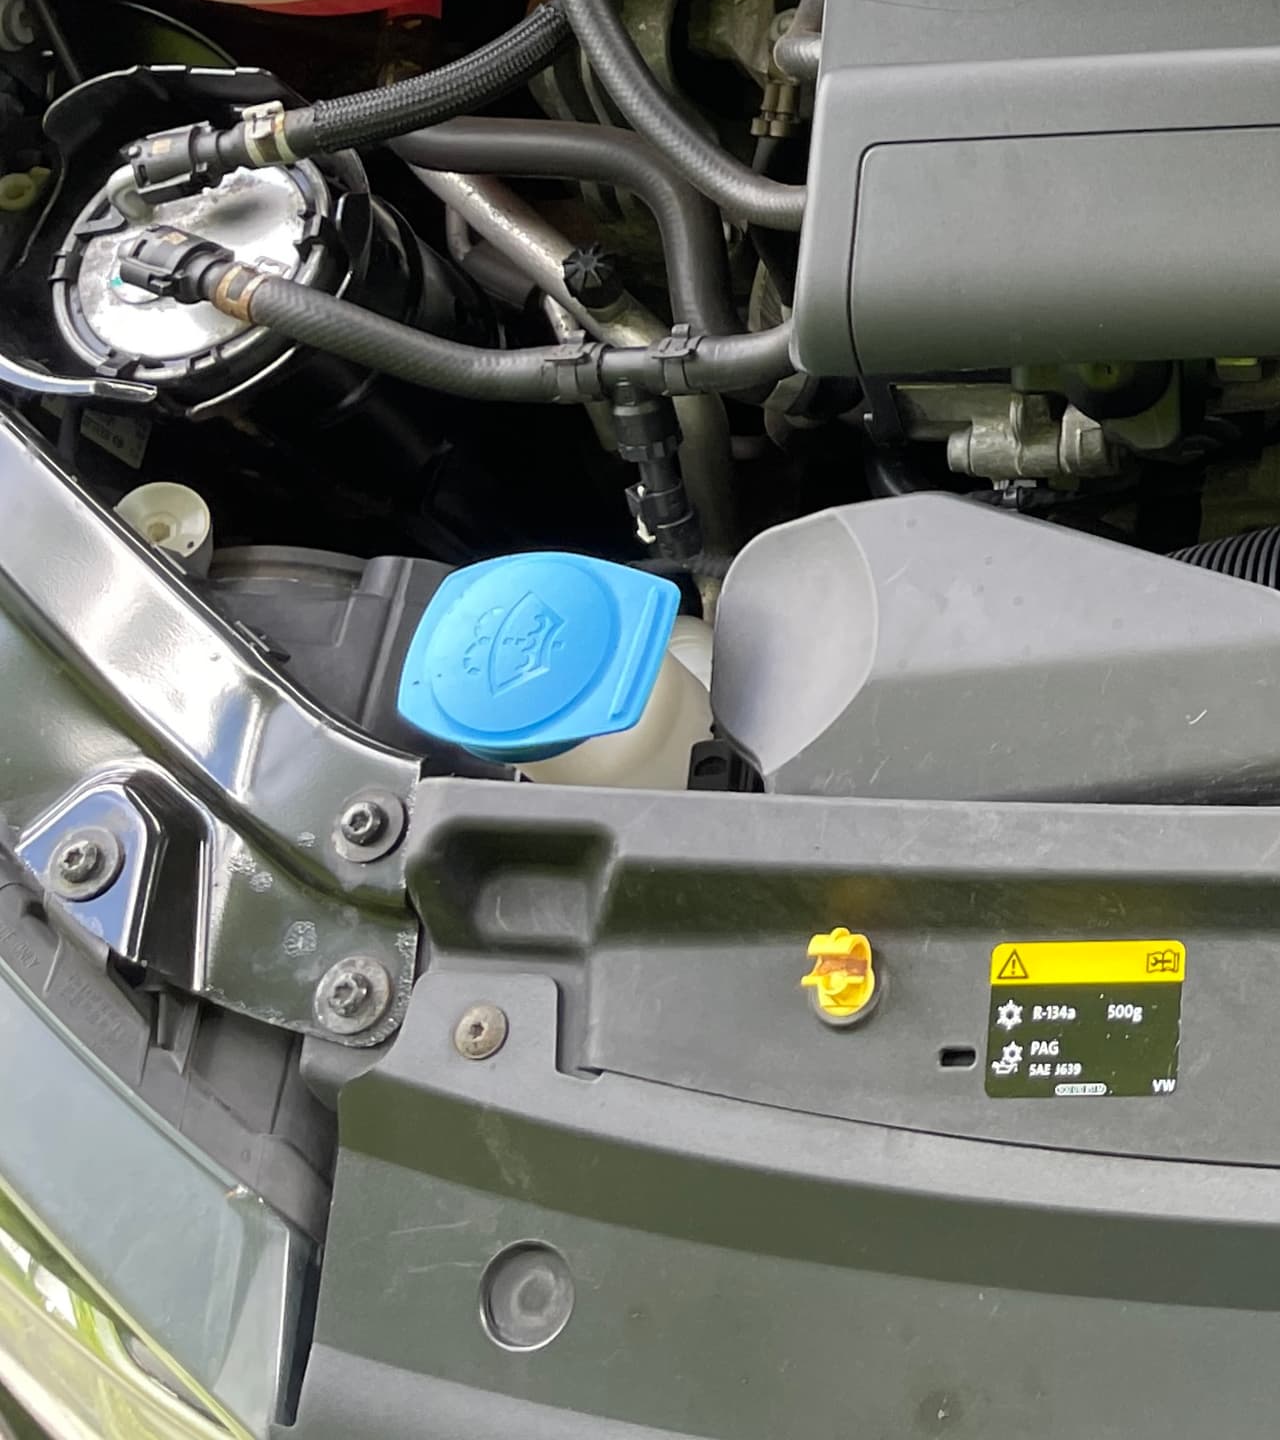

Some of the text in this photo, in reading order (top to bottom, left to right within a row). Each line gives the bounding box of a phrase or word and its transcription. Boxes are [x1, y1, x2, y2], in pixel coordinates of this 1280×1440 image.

[1032, 1003, 1143, 1023] R-134a 500g
[1029, 1041, 1059, 1056] PAG
[1029, 1062, 1082, 1077] SAE J639
[1152, 1079, 1176, 1093] VW
